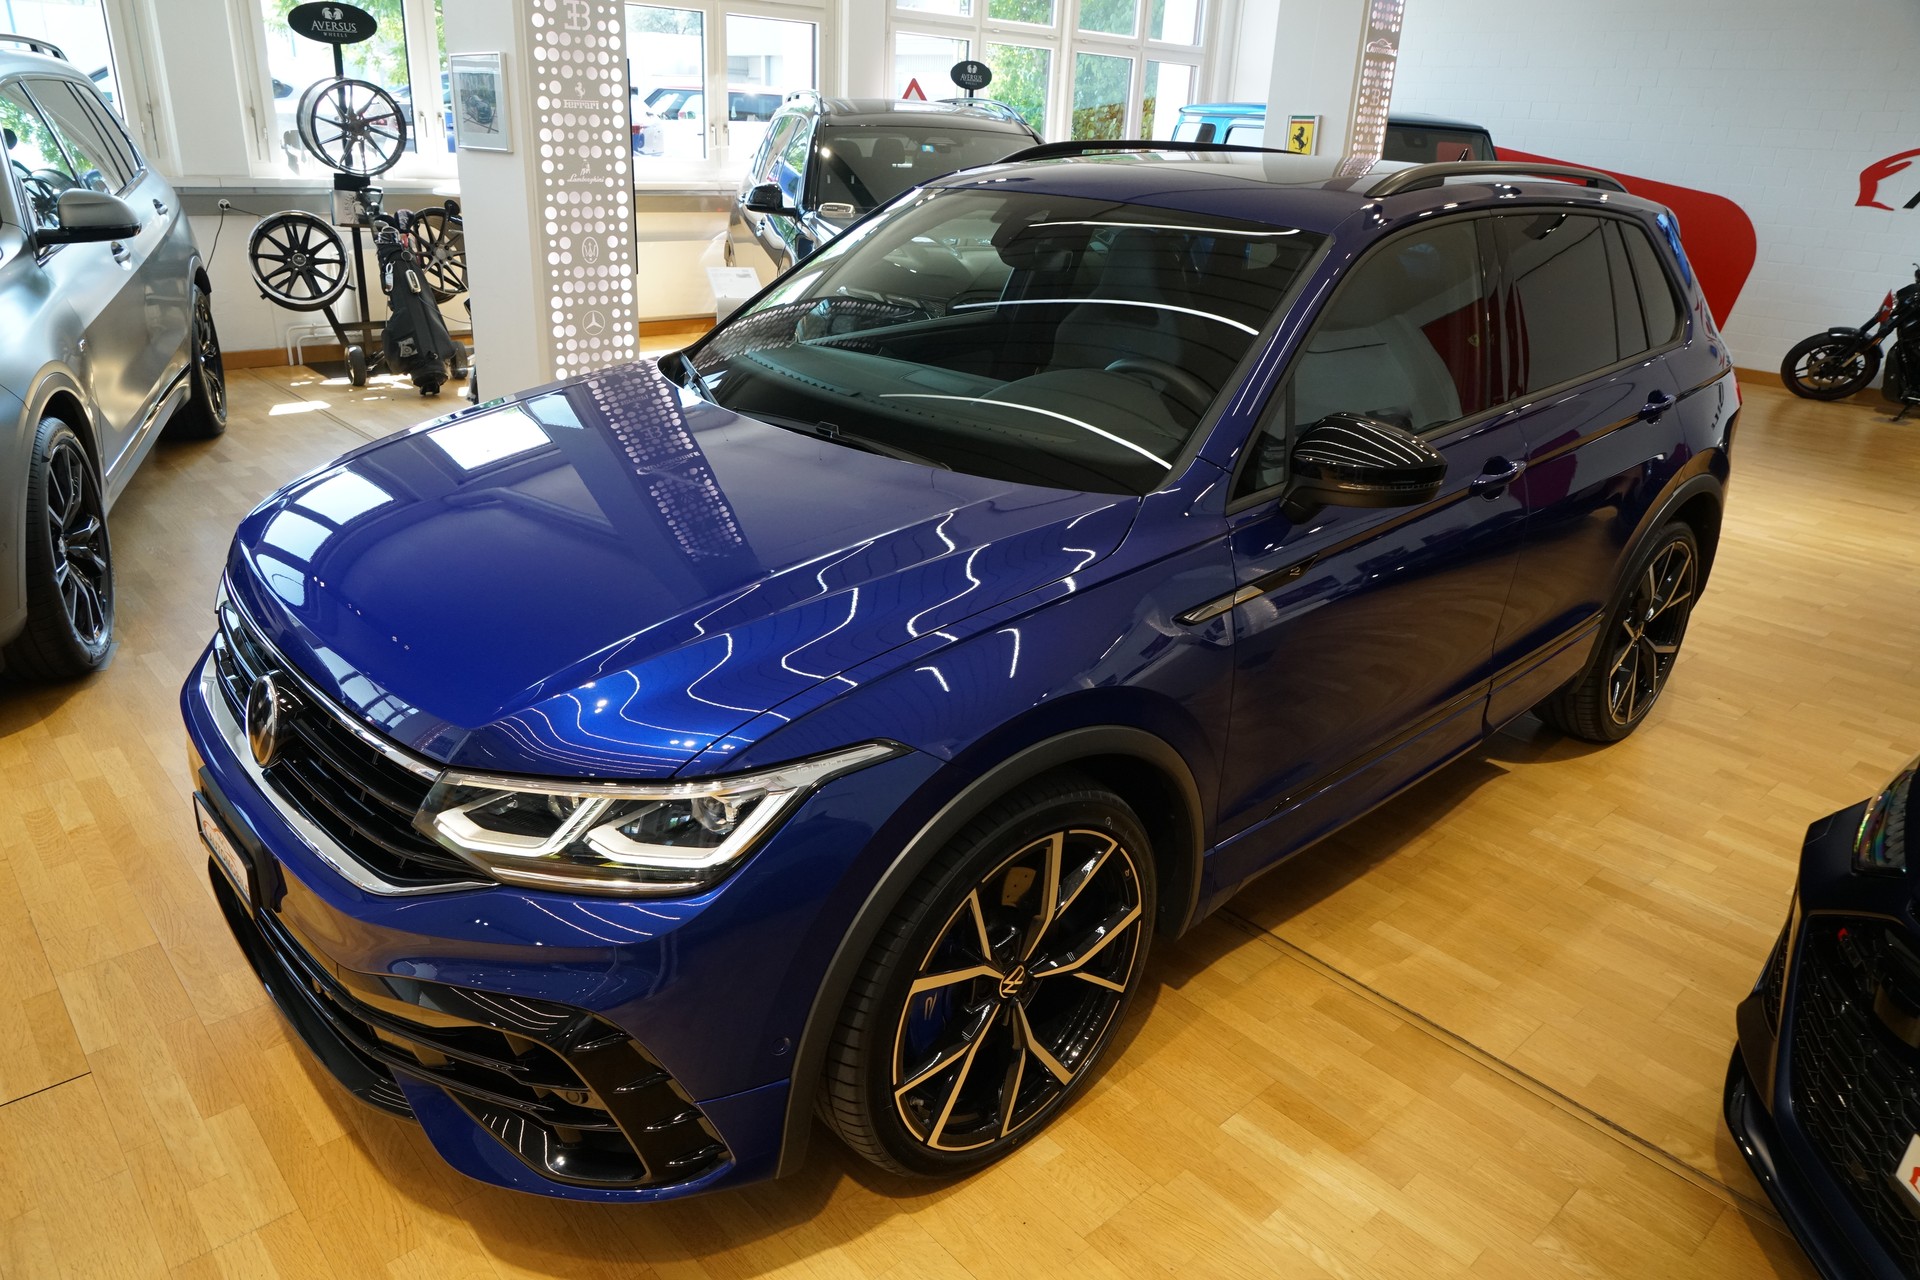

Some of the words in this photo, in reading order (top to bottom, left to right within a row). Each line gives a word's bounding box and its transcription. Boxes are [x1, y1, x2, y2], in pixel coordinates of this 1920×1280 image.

[311, 20, 357, 33] AVERSUS
[960, 73, 983, 82] AVERSUS
[563, 100, 600, 110] Ferrari
[567, 173, 605, 184] Lamborghini
